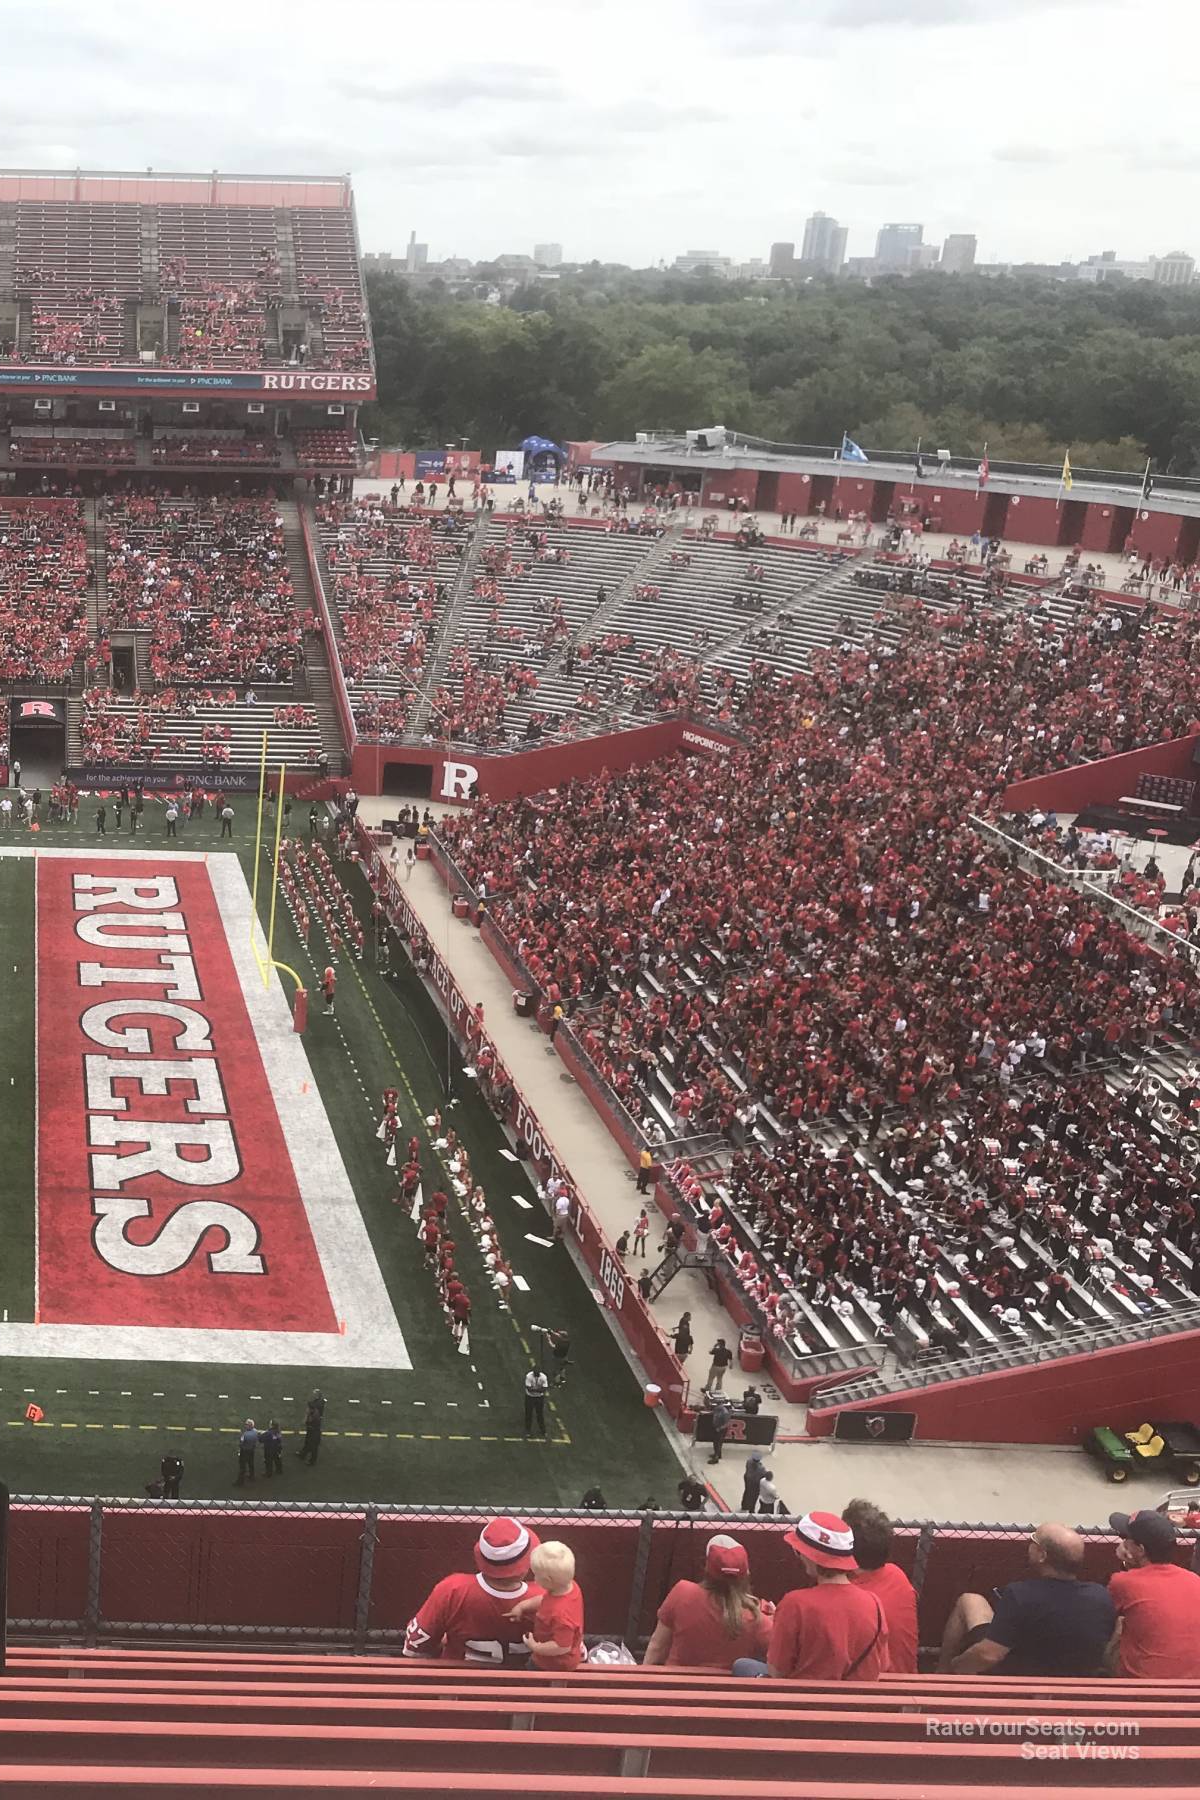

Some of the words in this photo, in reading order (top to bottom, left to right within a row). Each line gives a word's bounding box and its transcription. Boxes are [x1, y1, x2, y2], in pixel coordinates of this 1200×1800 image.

[263, 374, 371, 390] RUTGERS
[20, 701, 56, 717] R
[682, 730, 730, 755] HIGHPOINT.COM
[86, 774, 97, 782] for
[98, 774, 110, 782] the
[144, 775, 151, 783] in
[152, 776, 167, 784] you
[440, 761, 479, 800] R
[450, 988, 464, 1020] OF
[72, 873, 268, 1277] RUTGERS
[515, 1101, 585, 1243] FOOL
[599, 1249, 624, 1310] 1869
[28, 1407, 37, 1419] G
[725, 1419, 747, 1441] R
[818, 1531, 831, 1544] R
[405, 1616, 431, 1649] 27
